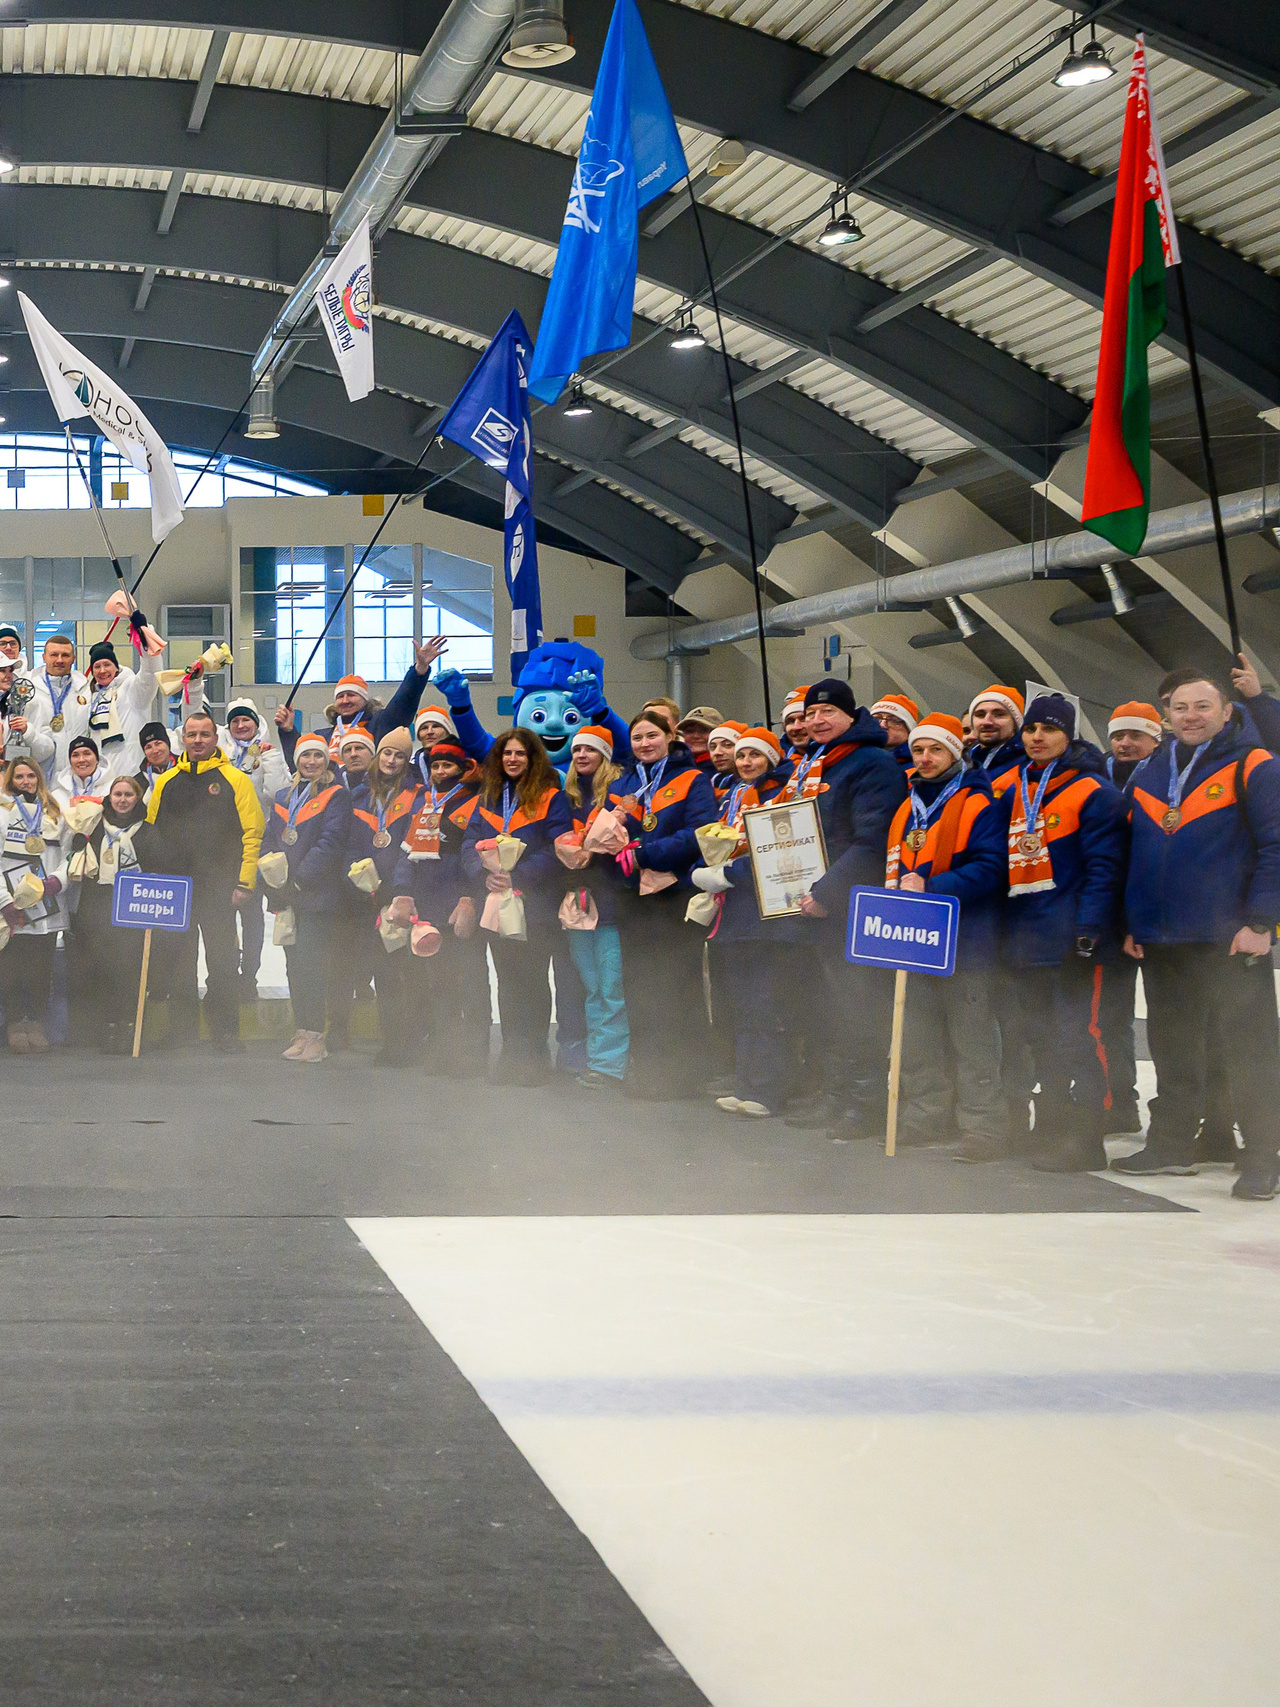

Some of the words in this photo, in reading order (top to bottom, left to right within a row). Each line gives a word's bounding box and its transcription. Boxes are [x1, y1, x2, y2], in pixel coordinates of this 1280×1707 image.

[334, 316, 355, 352] ТИГРЫ
[756, 835, 816, 854] СЕРТИФИКАТ
[132, 883, 174, 900] Белые
[128, 902, 174, 919] тигры
[863, 915, 940, 947] Молния
